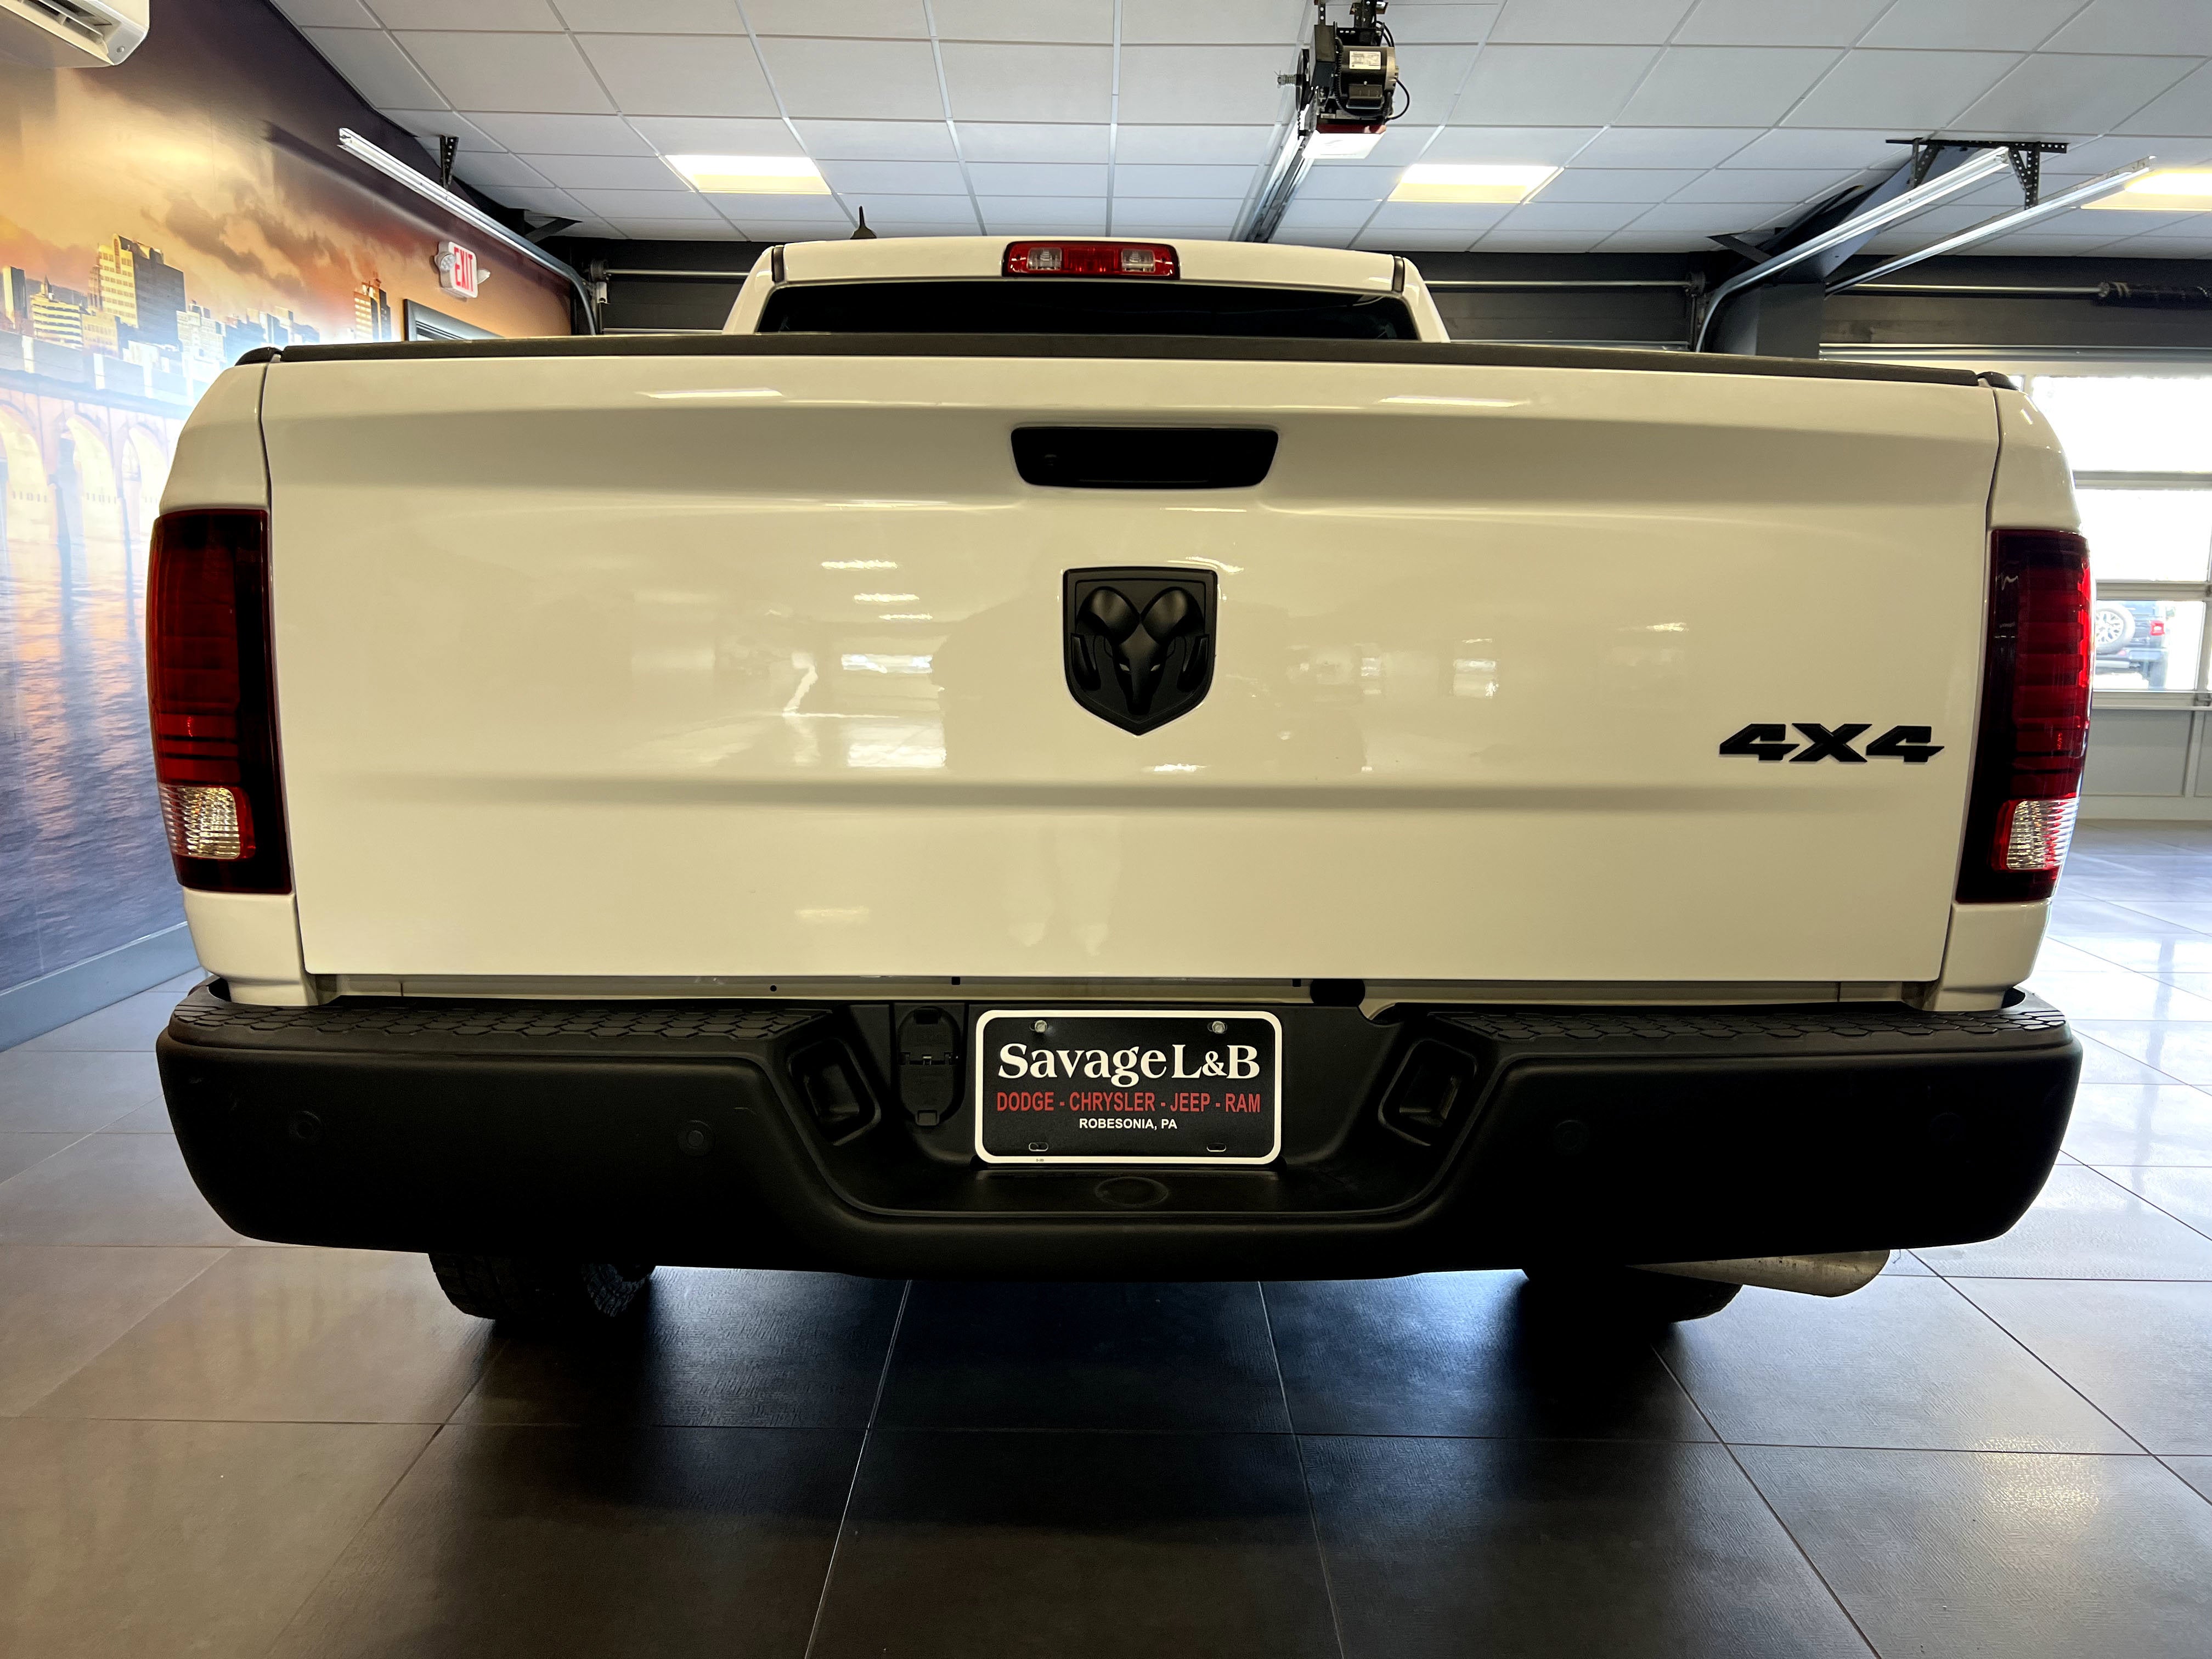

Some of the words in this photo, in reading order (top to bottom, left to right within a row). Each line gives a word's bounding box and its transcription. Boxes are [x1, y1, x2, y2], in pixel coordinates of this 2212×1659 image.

[454, 246, 473, 292] EXIT
[1719, 723, 1945, 763] 4X4
[997, 1091, 1054, 1111] DODGE
[1069, 1092, 1155, 1111] CHRYSLER
[1170, 1092, 1211, 1112] JEEP
[1225, 1093, 1261, 1113] RAM
[1079, 1118, 1157, 1131] ROBESONIA,
[1161, 1119, 1178, 1129] PA
